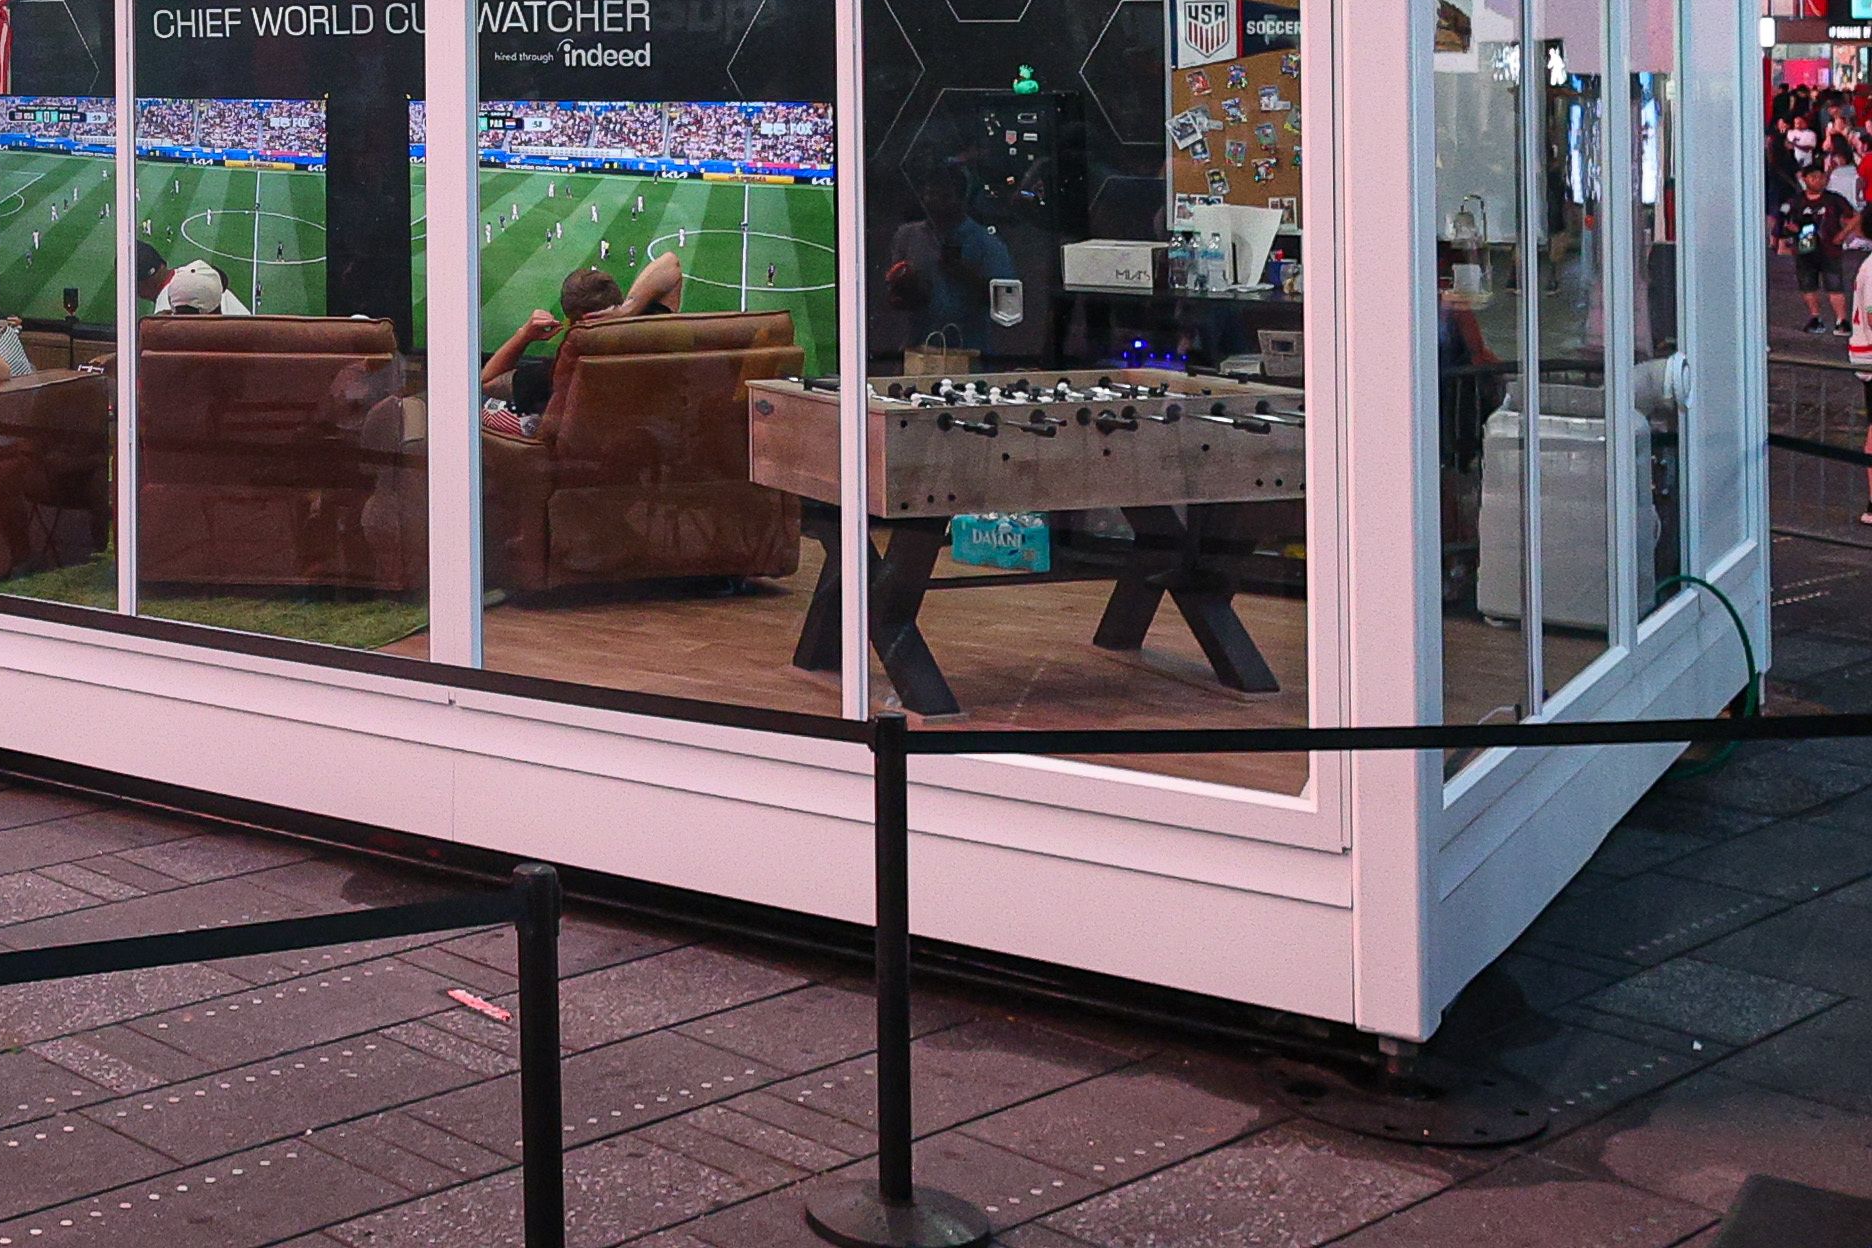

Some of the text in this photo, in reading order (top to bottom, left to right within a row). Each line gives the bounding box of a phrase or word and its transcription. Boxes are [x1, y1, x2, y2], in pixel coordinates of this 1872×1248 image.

[153, 0, 651, 39] CHIEF WORLD CU WATCHER
[1187, 4, 1226, 25] USA
[494, 38, 651, 67] hired through indeed
[292, 118, 310, 128] FOX
